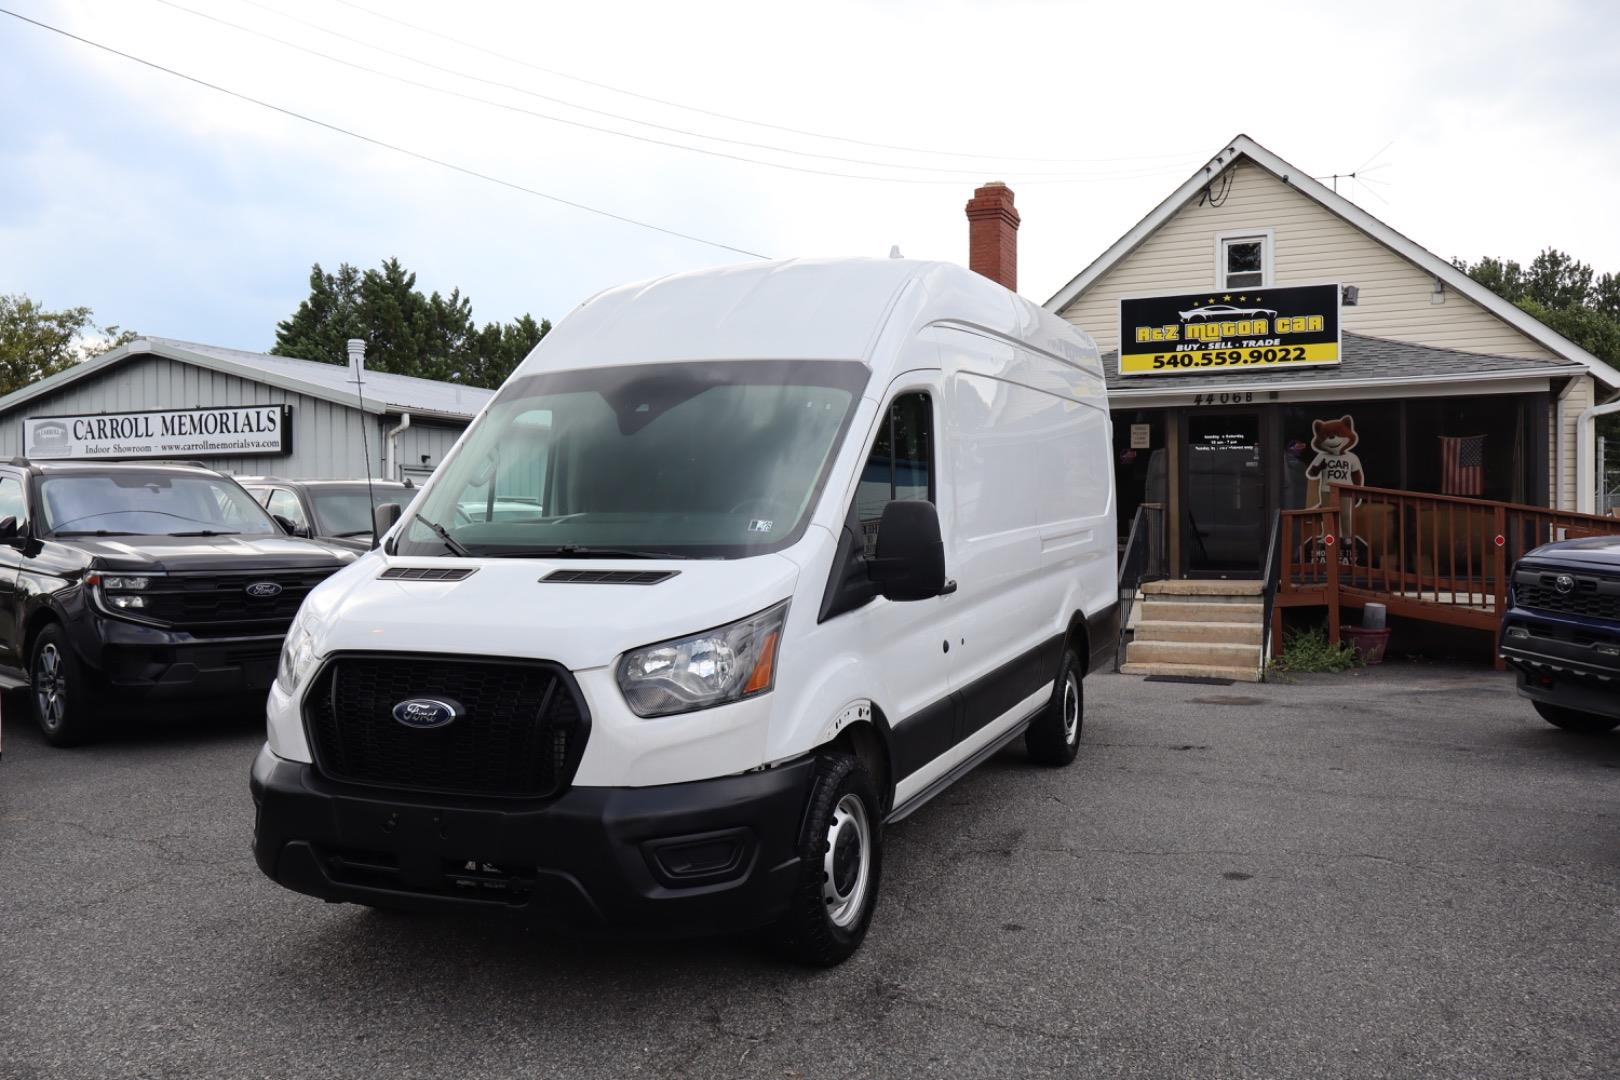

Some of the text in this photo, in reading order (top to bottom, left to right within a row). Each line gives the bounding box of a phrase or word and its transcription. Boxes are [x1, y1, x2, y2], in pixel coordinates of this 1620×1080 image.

[1176, 338, 1281, 352] BUY SELL TRADE
[1153, 347, 1307, 369] 540.559.9022
[73, 409, 277, 441] CARROLL MEMORIALS
[85, 439, 280, 455] Indoor Showroom www.carrollmemorialsva.com
[1327, 459, 1350, 470] CAR
[1327, 470, 1348, 480] FOX
[252, 584, 276, 595] Ford
[402, 702, 438, 722] Ford
